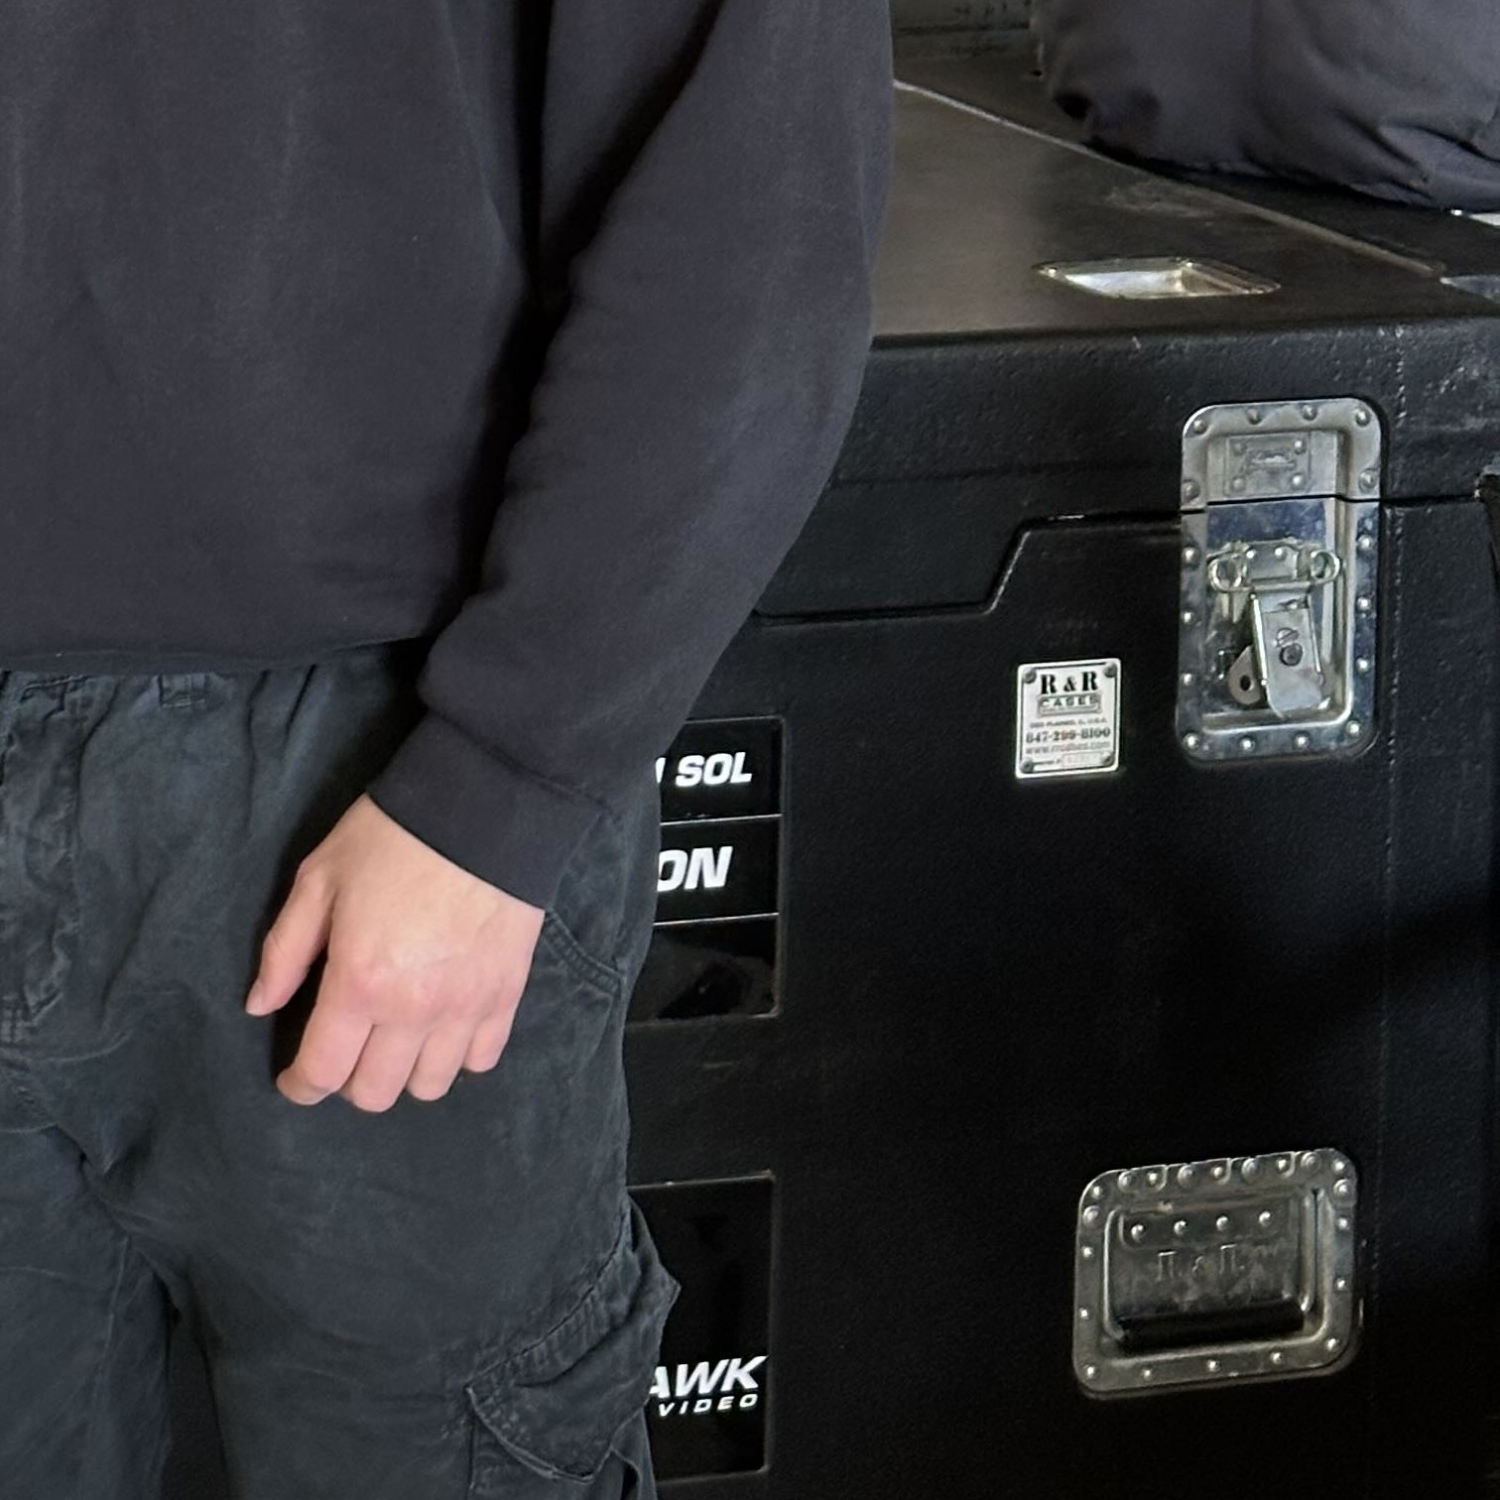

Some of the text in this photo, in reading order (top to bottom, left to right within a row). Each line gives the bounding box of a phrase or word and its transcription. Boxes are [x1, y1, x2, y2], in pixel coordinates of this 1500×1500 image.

[1040, 670, 1098, 695] R & R
[675, 752, 753, 787] SOL
[658, 1393, 759, 1417] VIDEO
